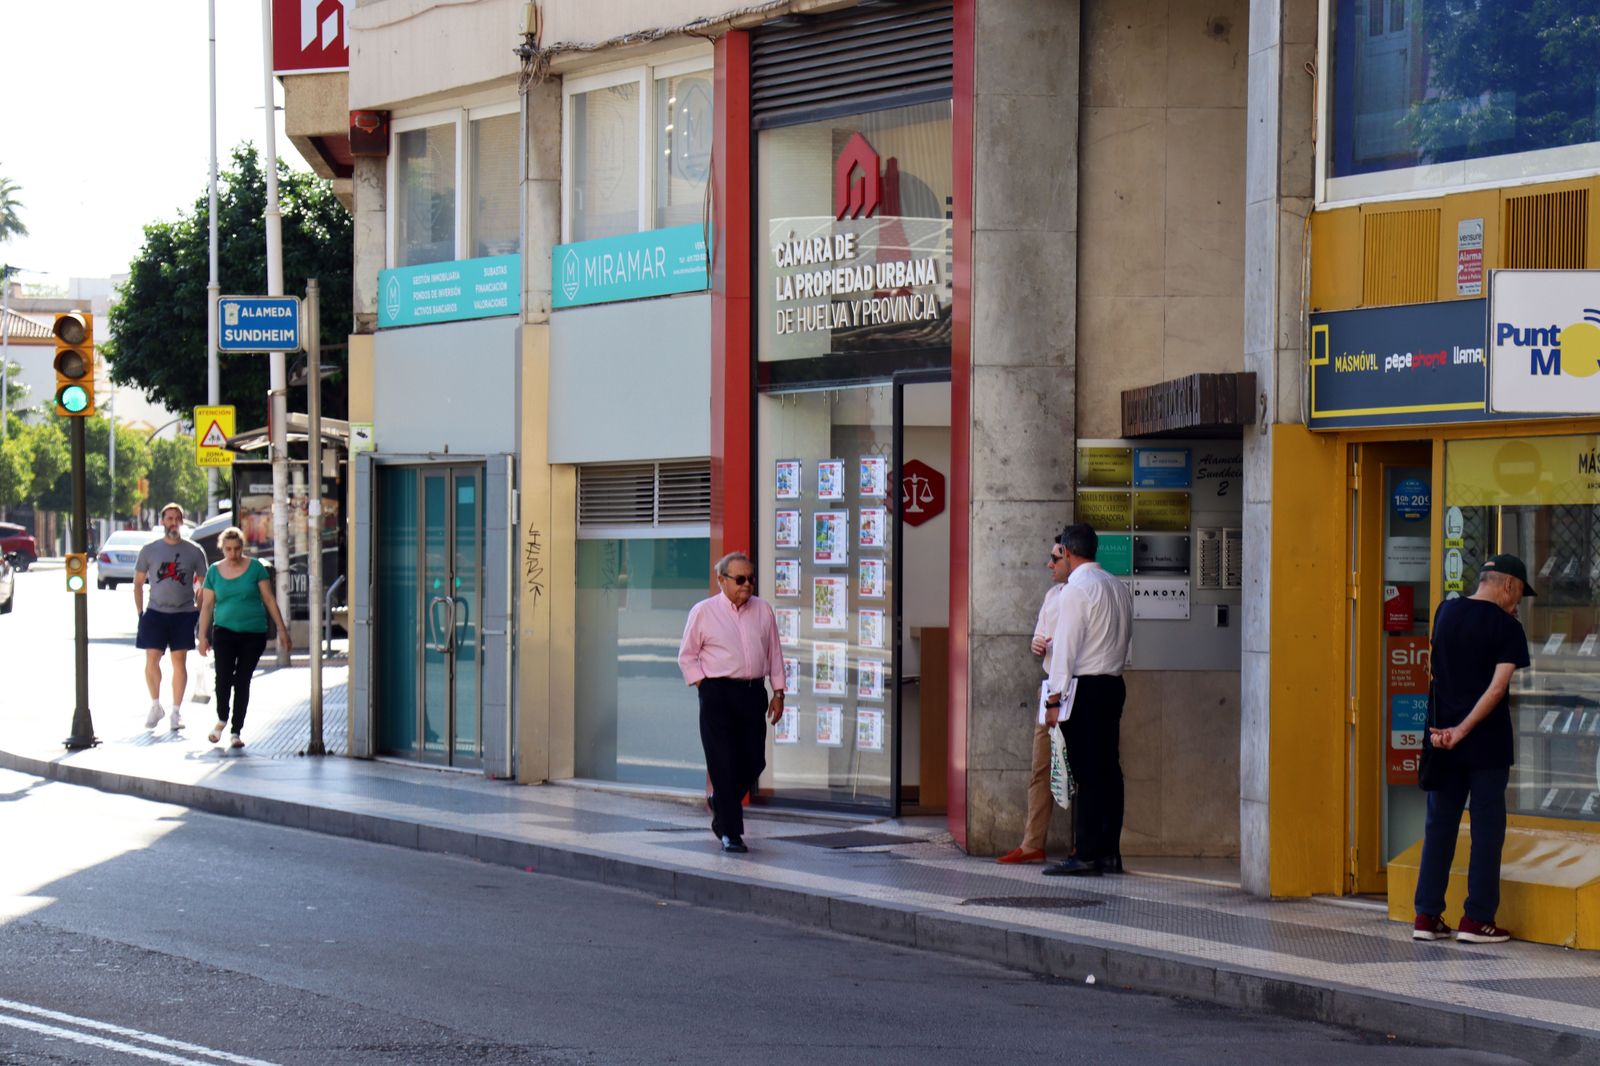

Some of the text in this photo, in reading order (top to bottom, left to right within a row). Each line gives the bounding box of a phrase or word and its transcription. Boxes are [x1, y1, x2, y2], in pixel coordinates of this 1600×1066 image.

[776, 230, 857, 268] CÁMARA DE
[1459, 252, 1482, 261] Alarma
[484, 265, 508, 277] SUBASTAS
[585, 246, 667, 288] MIRAMAR
[413, 271, 460, 286] GESTIÓN INMOBILIARIA
[776, 259, 938, 301] LA PROPIEDAD URBANA
[413, 286, 461, 302] FONDOS DE INVERSIÓN
[476, 281, 508, 294] FINANCIACIÓN
[414, 303, 457, 317] ACTIVOS BANCARIOS
[474, 298, 508, 311] VALORACIONES
[242, 307, 293, 318] ALAMEDA
[777, 293, 938, 335] DE HUELVA Y PROVINCIA
[225, 329, 295, 342] SUNDHEIM
[1385, 349, 1447, 373] pepephone
[198, 408, 231, 416] ATENCIÓN
[1216, 480, 1229, 497] 2
